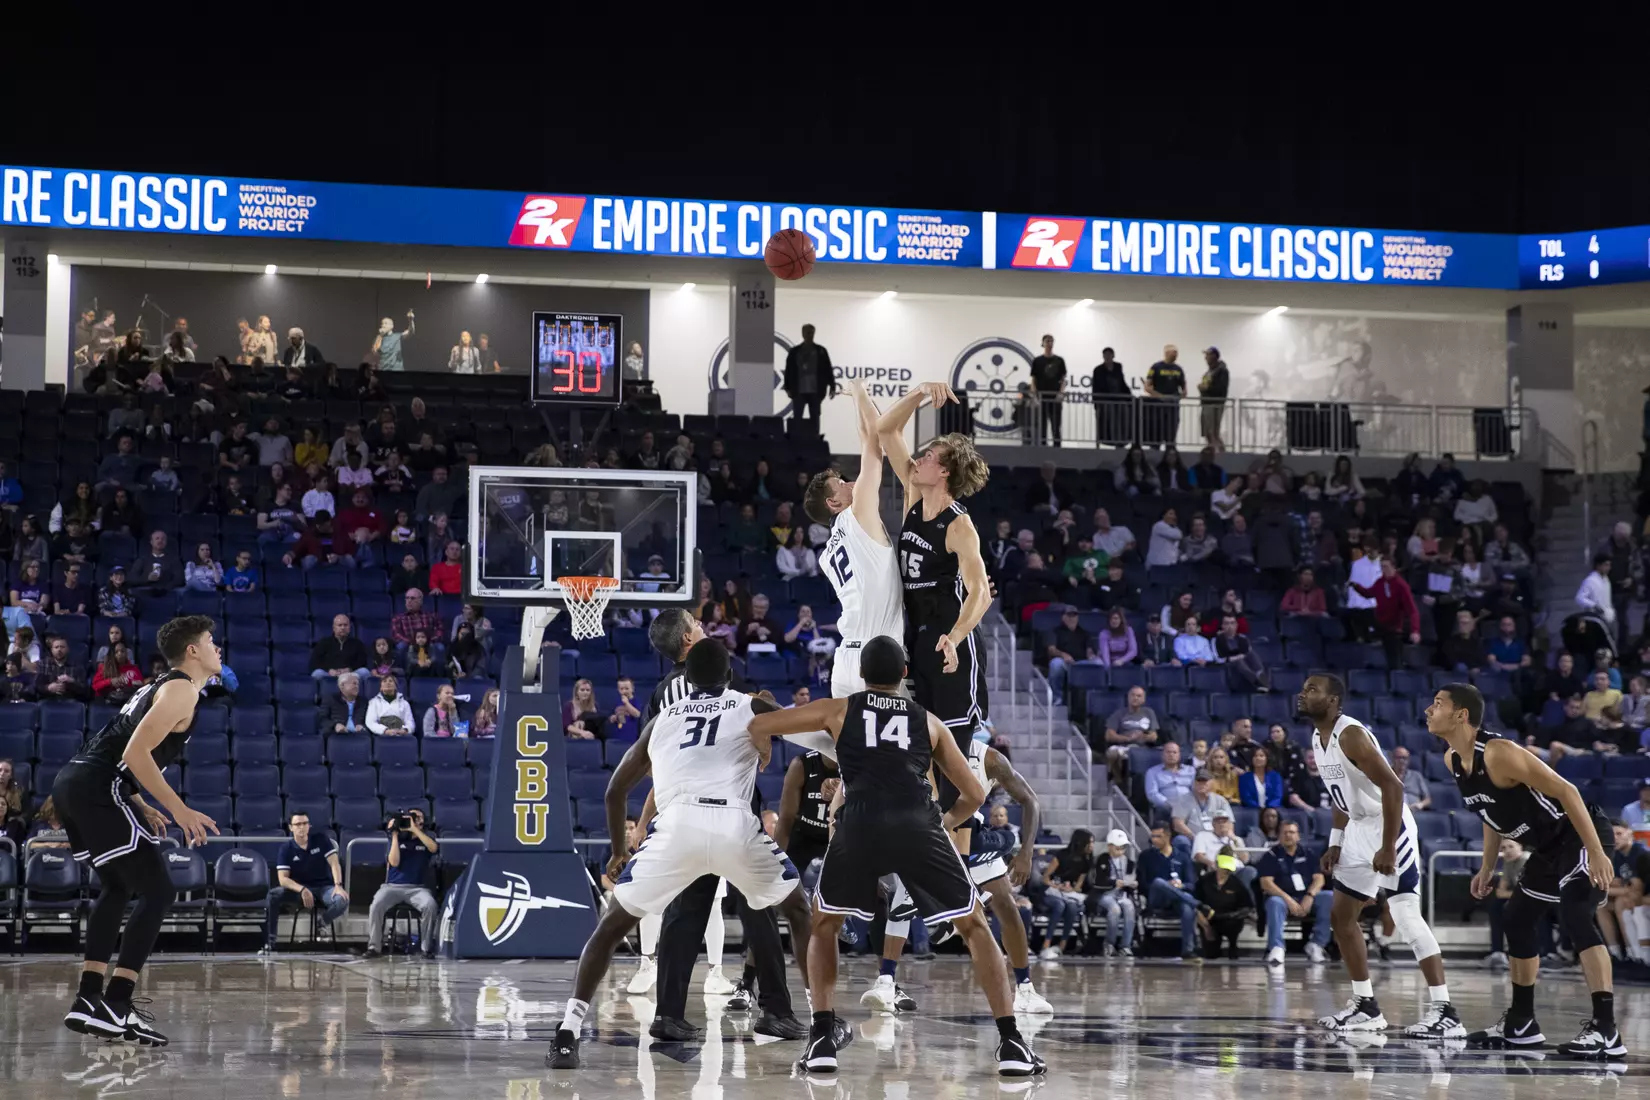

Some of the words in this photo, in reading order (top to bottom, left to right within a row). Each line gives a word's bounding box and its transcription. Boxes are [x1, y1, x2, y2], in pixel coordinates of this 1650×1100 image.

[239, 184, 287, 193] BENEFITING
[3, 168, 52, 223] RE
[63, 172, 227, 232] CLASSIC
[239, 192, 317, 207] WOUNDED
[239, 205, 309, 219] WARRIOR
[898, 214, 942, 223] BENEFITING
[239, 218, 304, 232] PROJECT
[518, 198, 574, 245] 2K
[593, 197, 727, 254] EMPIRE
[898, 222, 970, 237] WOUNDED
[898, 235, 963, 249] WARRIOR
[1538, 239, 1566, 257] TOL
[1588, 234, 1600, 254] 4
[898, 247, 959, 261] PROJECT
[1021, 221, 1074, 267] 2K
[1092, 220, 1221, 275] EMPIRE
[1230, 226, 1373, 281] CLASSIC
[1383, 243, 1453, 257] WOUNDED
[17, 256, 35, 266] 112
[1383, 255, 1447, 269] WARRIOR
[1383, 267, 1444, 281] PROJECT
[1540, 264, 1565, 281] FLS
[745, 290, 765, 299] 113
[745, 300, 765, 310] 114
[553, 350, 601, 392] 30
[832, 366, 912, 381] QUIPPED
[829, 545, 853, 588] 12
[901, 549, 923, 578] 15
[668, 702, 720, 717] FLAVORS
[867, 693, 908, 711] COOPER
[680, 714, 722, 749] 31
[863, 709, 911, 750] 14
[514, 715, 549, 845] CBU
[1331, 784, 1349, 812] 0
